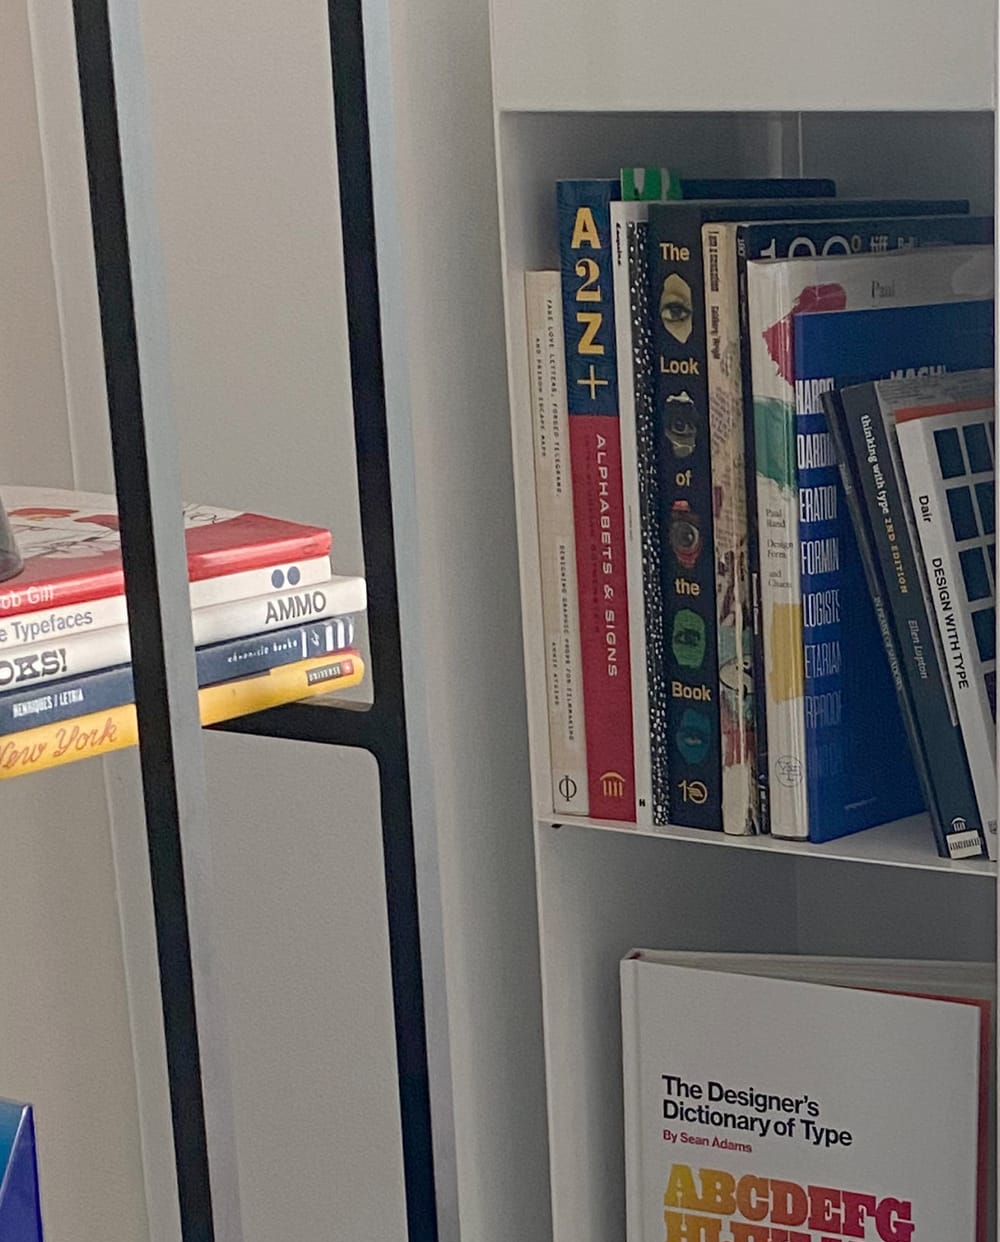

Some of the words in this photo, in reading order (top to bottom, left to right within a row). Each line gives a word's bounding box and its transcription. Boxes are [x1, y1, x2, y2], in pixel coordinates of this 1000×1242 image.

[660, 243, 690, 261] The
[660, 356, 700, 375] Look
[861, 414, 878, 464] thinking
[676, 469, 692, 487] of
[871, 463, 885, 490] with
[594, 433, 612, 574] ALPHABETS
[877, 487, 891, 514] type
[919, 495, 932, 523] Dair
[884, 517, 896, 542] 2ND
[892, 544, 908, 593] EDITION
[602, 583, 614, 600] &
[675, 578, 700, 596] the
[932, 558, 952, 612] DESIGN
[265, 590, 326, 624] AMMO
[11, 611, 93, 642] Typefaces
[907, 618, 920, 646] Ellen
[944, 613, 961, 652] WITH
[604, 608, 618, 677] SIGNS
[911, 645, 928, 680] Lupton
[952, 654, 969, 690] TYPE
[671, 681, 712, 701] Book
[53, 717, 117, 757] York
[662, 1074, 703, 1100] The
[708, 1081, 820, 1117] Designer's
[662, 1099, 770, 1138] Dictionary
[773, 1117, 797, 1138] of
[800, 1118, 853, 1148] Type
[662, 1129, 678, 1144] By
[680, 1131, 710, 1147] Sean
[711, 1137, 753, 1153] Adams
